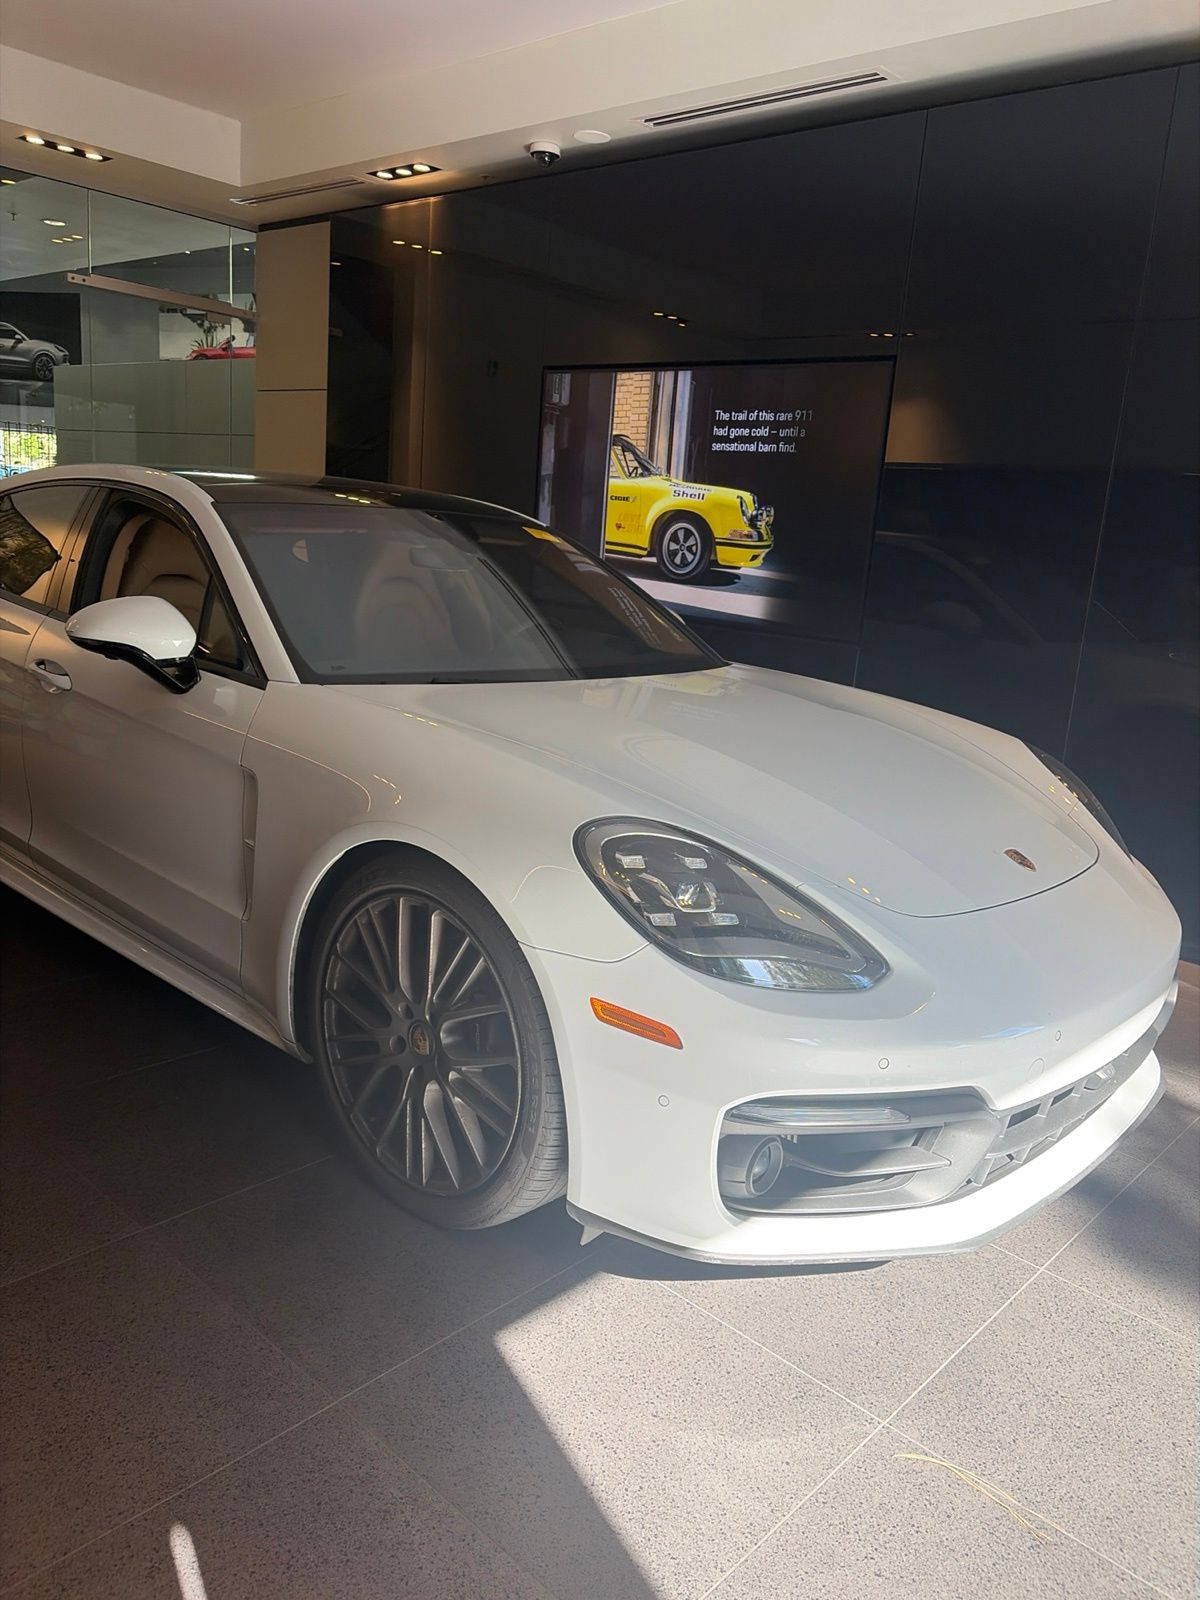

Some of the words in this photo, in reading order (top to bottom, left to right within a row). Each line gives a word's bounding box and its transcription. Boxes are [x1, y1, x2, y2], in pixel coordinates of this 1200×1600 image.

[715, 410, 730, 421] The
[731, 410, 748, 421] trail
[748, 410, 759, 421] of
[759, 410, 775, 421] this
[775, 412, 793, 421] rare
[794, 409, 813, 421] 911
[713, 426, 728, 437] had
[729, 428, 750, 439] gone
[751, 426, 769, 437] cold
[779, 426, 799, 437] until
[799, 428, 806, 437] a
[711, 441, 757, 452] sensational
[758, 441, 777, 453] barn
[778, 441, 797, 453] find.
[672, 489, 705, 501] Shell
